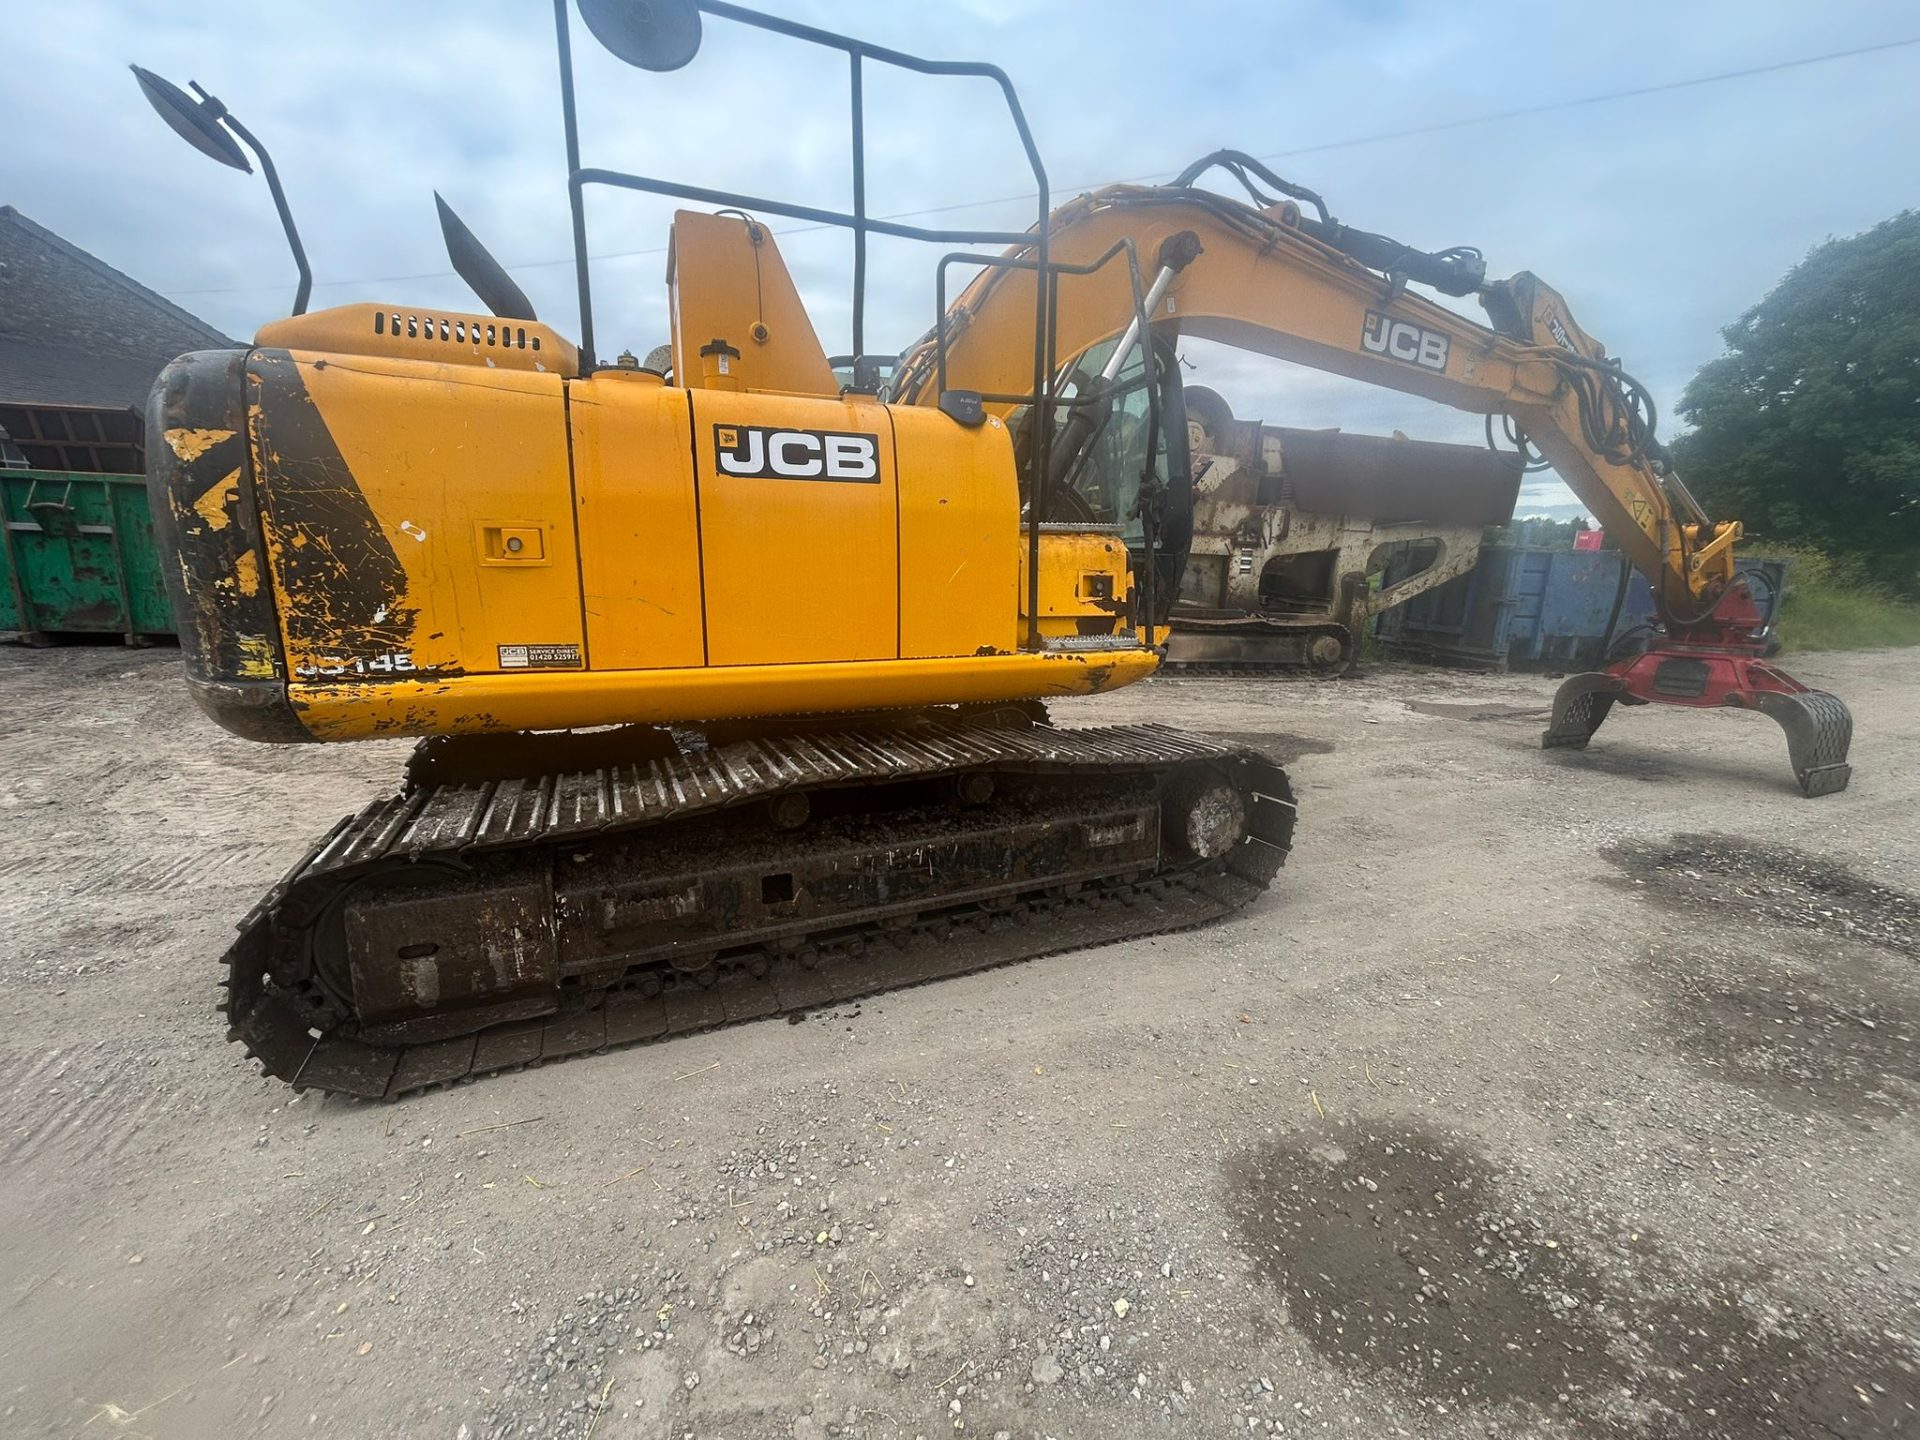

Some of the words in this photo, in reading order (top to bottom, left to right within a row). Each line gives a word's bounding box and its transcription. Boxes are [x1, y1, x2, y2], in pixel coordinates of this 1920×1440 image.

[1363, 319, 1448, 369] JCB
[720, 431, 877, 479] JCB
[502, 648, 527, 656] JCB
[529, 653, 552, 661] 01420
